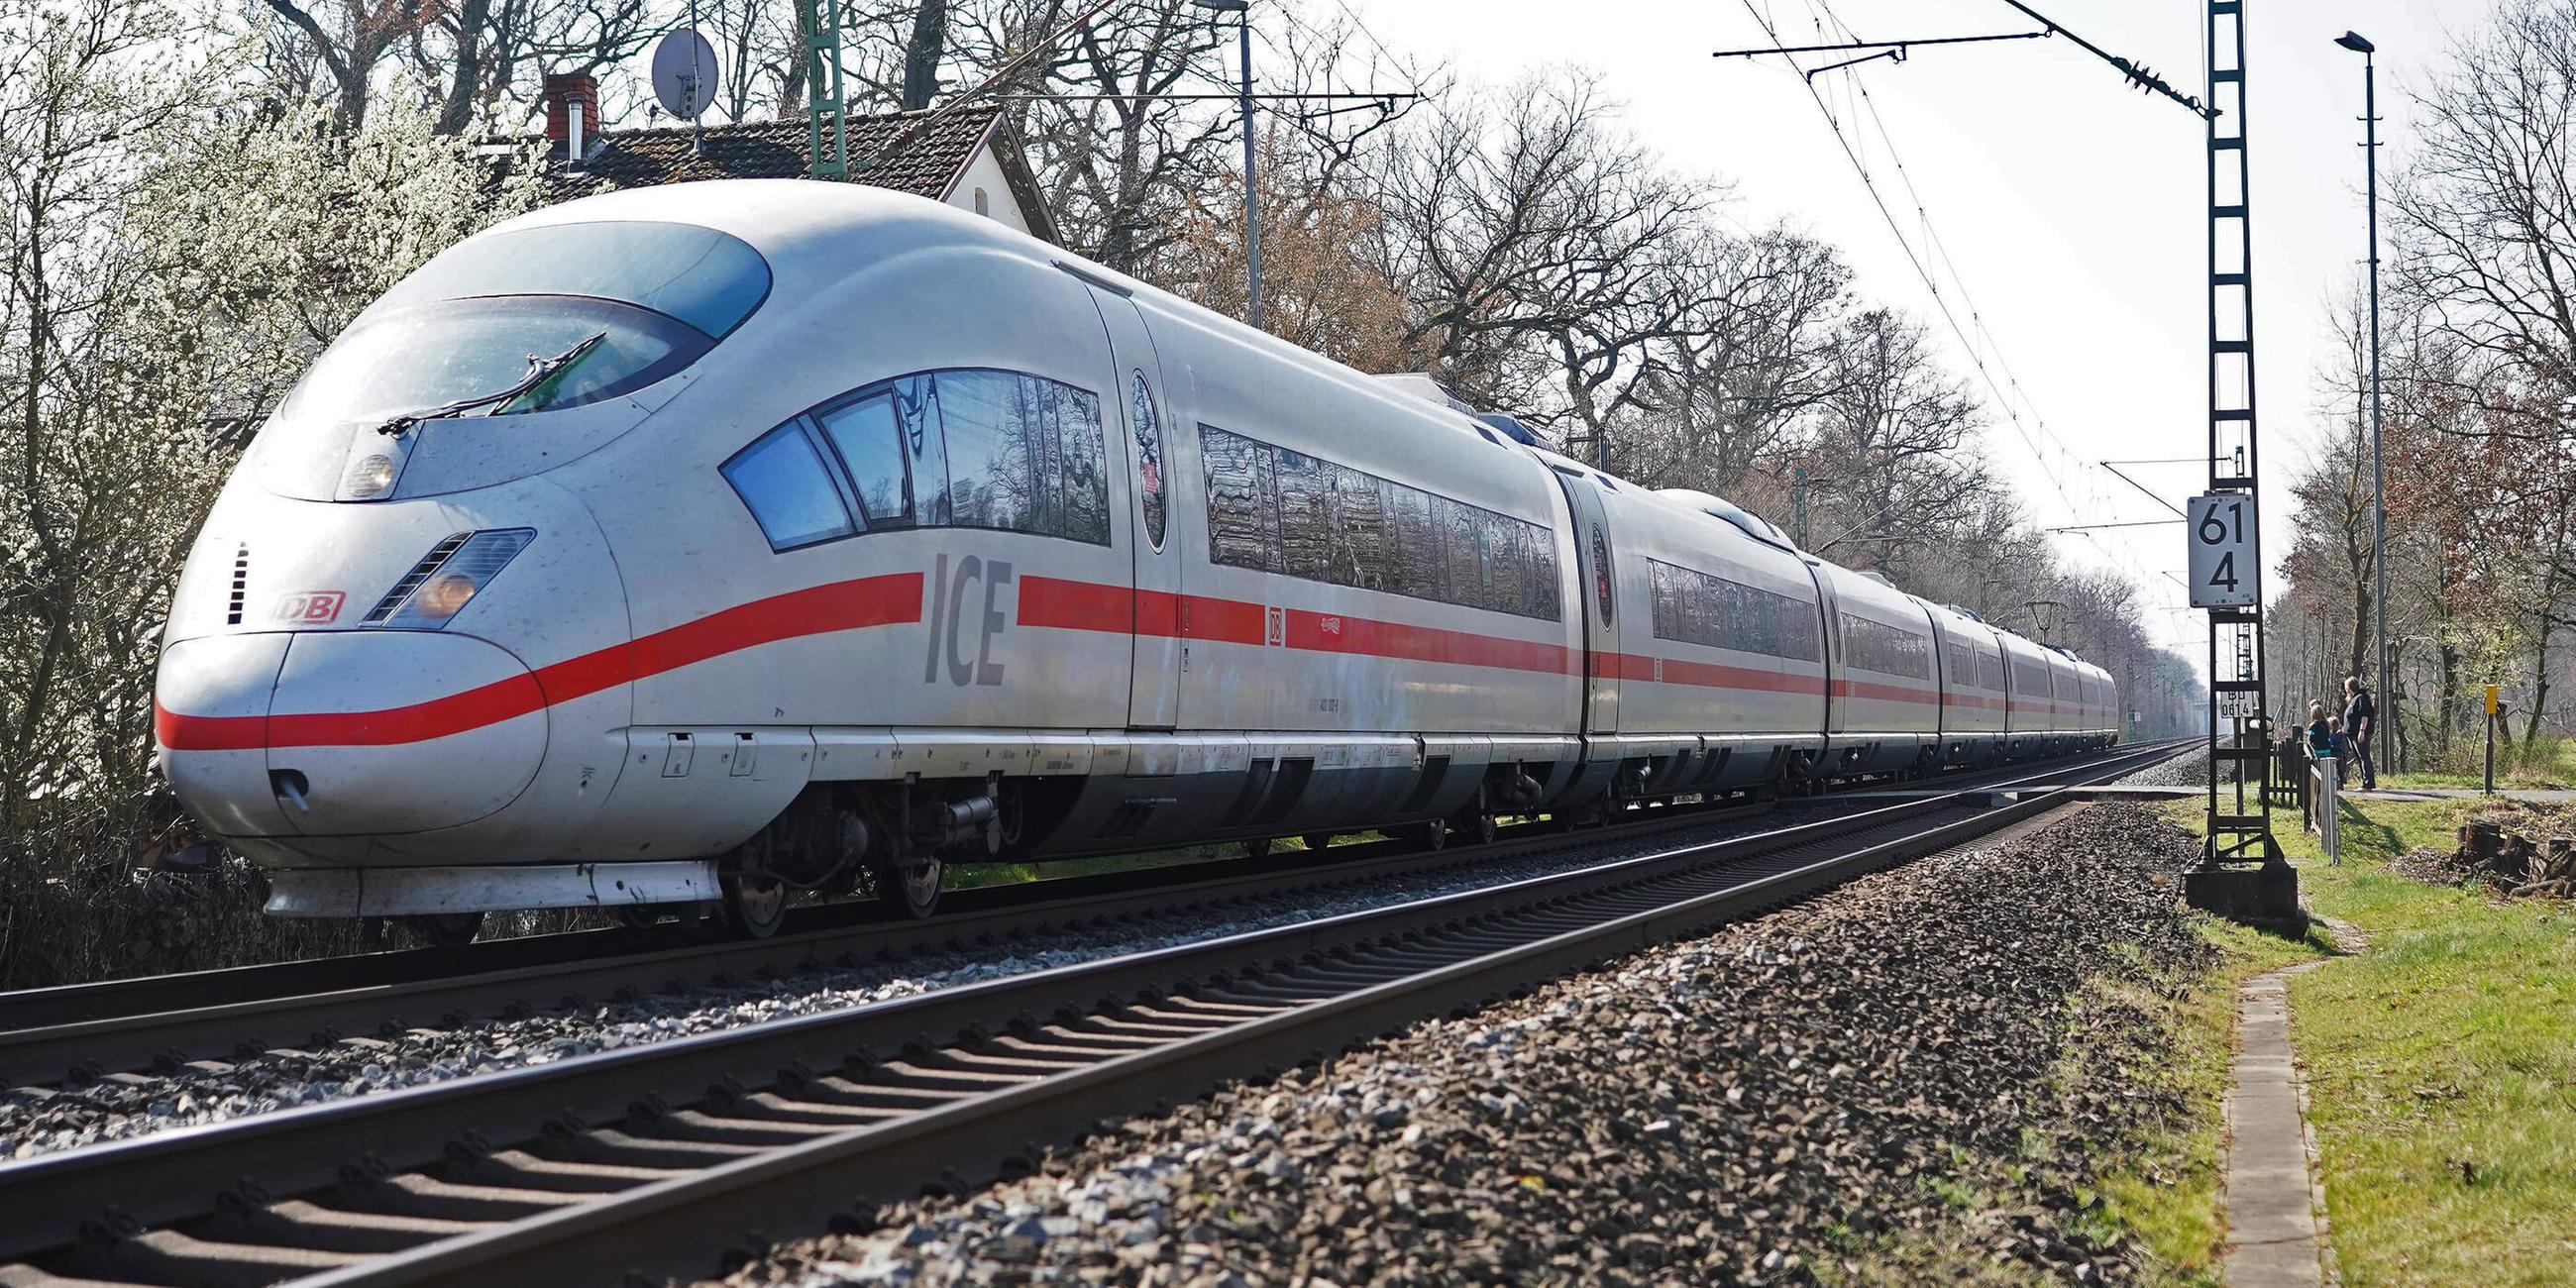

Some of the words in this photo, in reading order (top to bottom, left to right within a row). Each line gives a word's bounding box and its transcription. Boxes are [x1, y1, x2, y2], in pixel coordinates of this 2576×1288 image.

[2199, 501, 2243, 545] 61
[2208, 551, 2239, 593] 4
[277, 595, 336, 620] DB
[924, 553, 1013, 688] ICE
[1270, 611, 1281, 643] DB
[2222, 703, 2250, 716] 061.4
